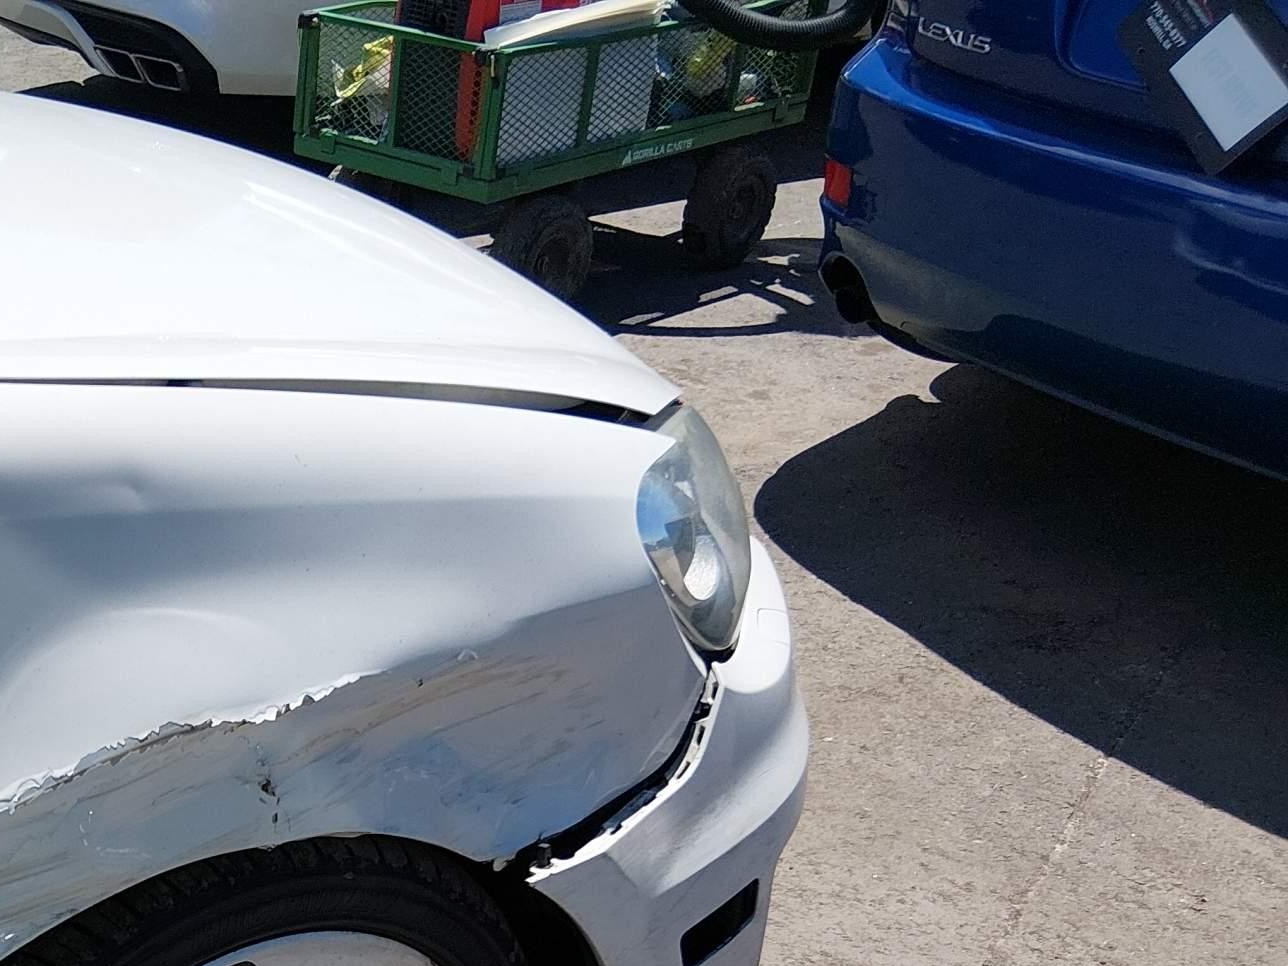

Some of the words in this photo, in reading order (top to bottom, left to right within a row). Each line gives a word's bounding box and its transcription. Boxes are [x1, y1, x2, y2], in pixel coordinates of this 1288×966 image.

[918, 16, 991, 54] LEXUS
[632, 145, 665, 160] GORILLA
[666, 138, 695, 153] CARTS
